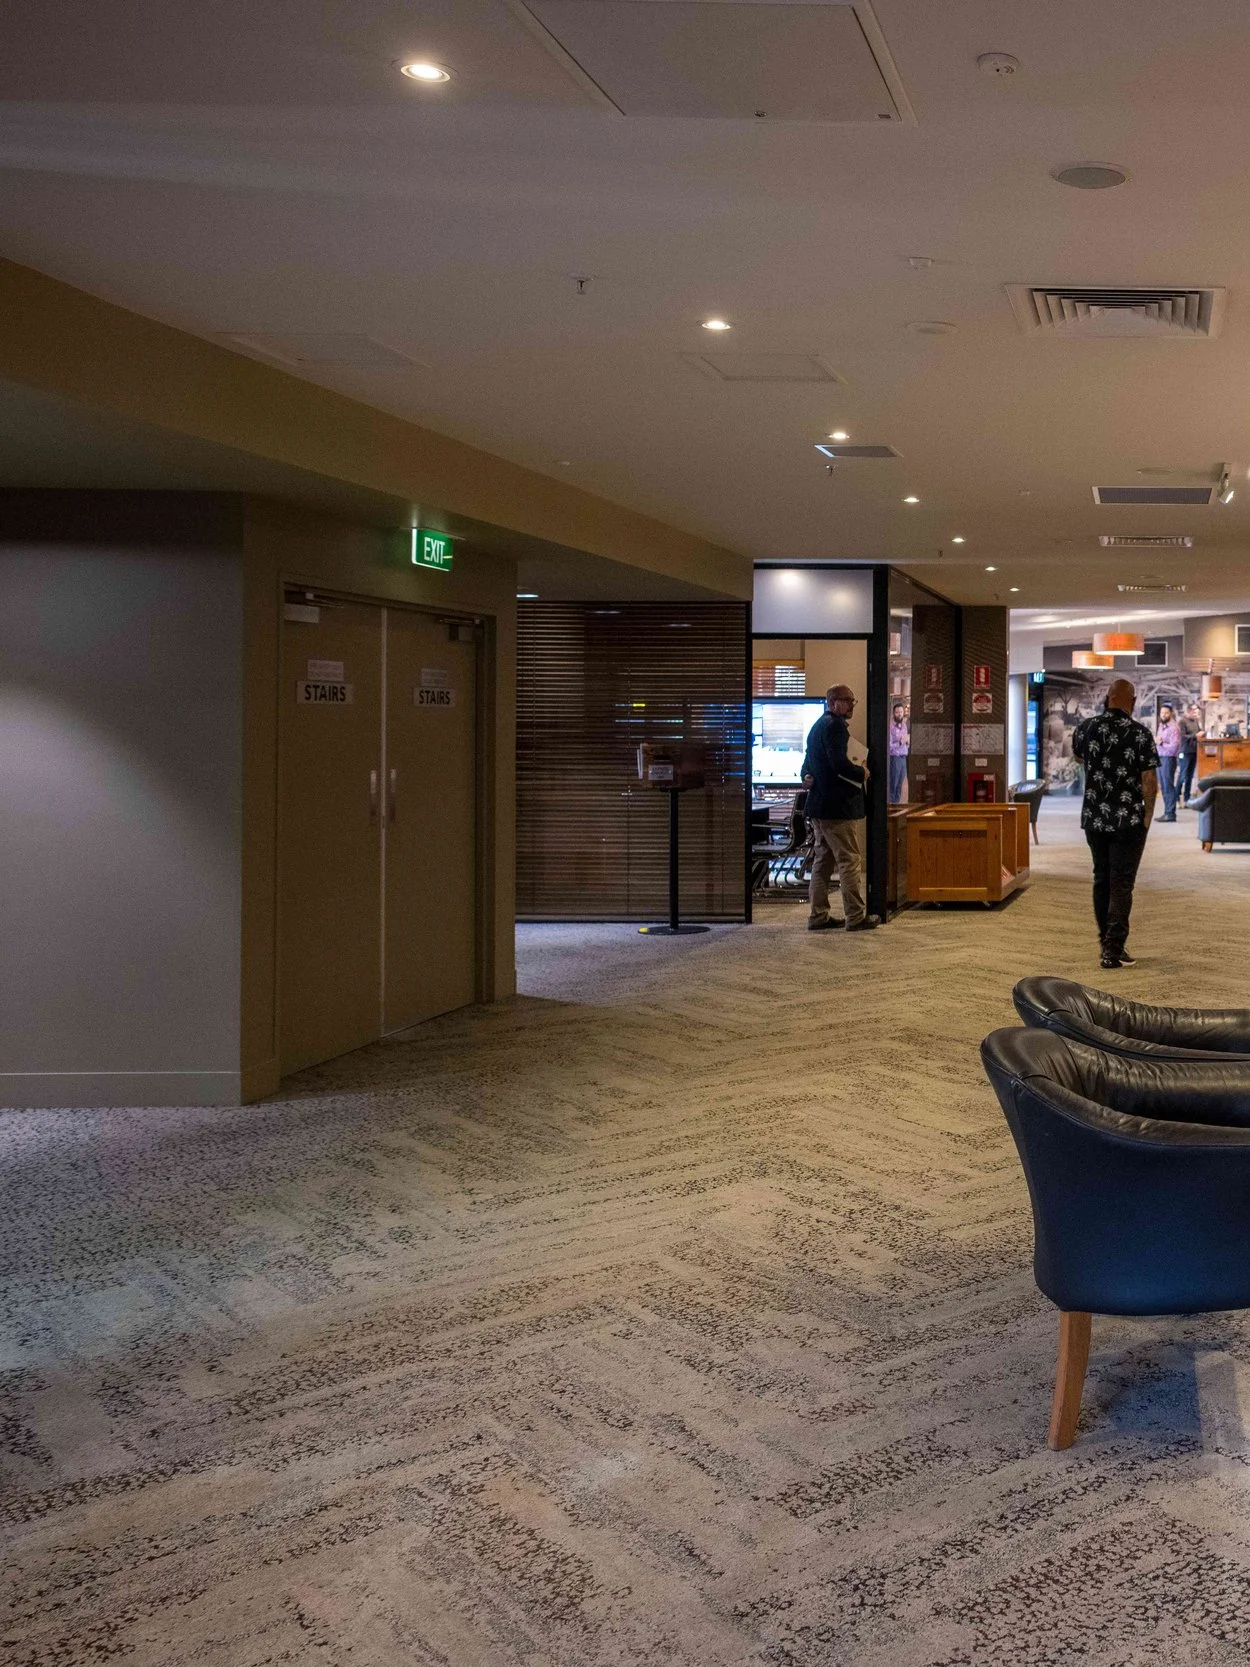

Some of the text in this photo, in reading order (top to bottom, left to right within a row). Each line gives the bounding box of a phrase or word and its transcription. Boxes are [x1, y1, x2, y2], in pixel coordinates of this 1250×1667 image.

[424, 536, 446, 564] EXIT
[304, 684, 346, 702] STAIRS
[418, 690, 450, 705] STAIRS
